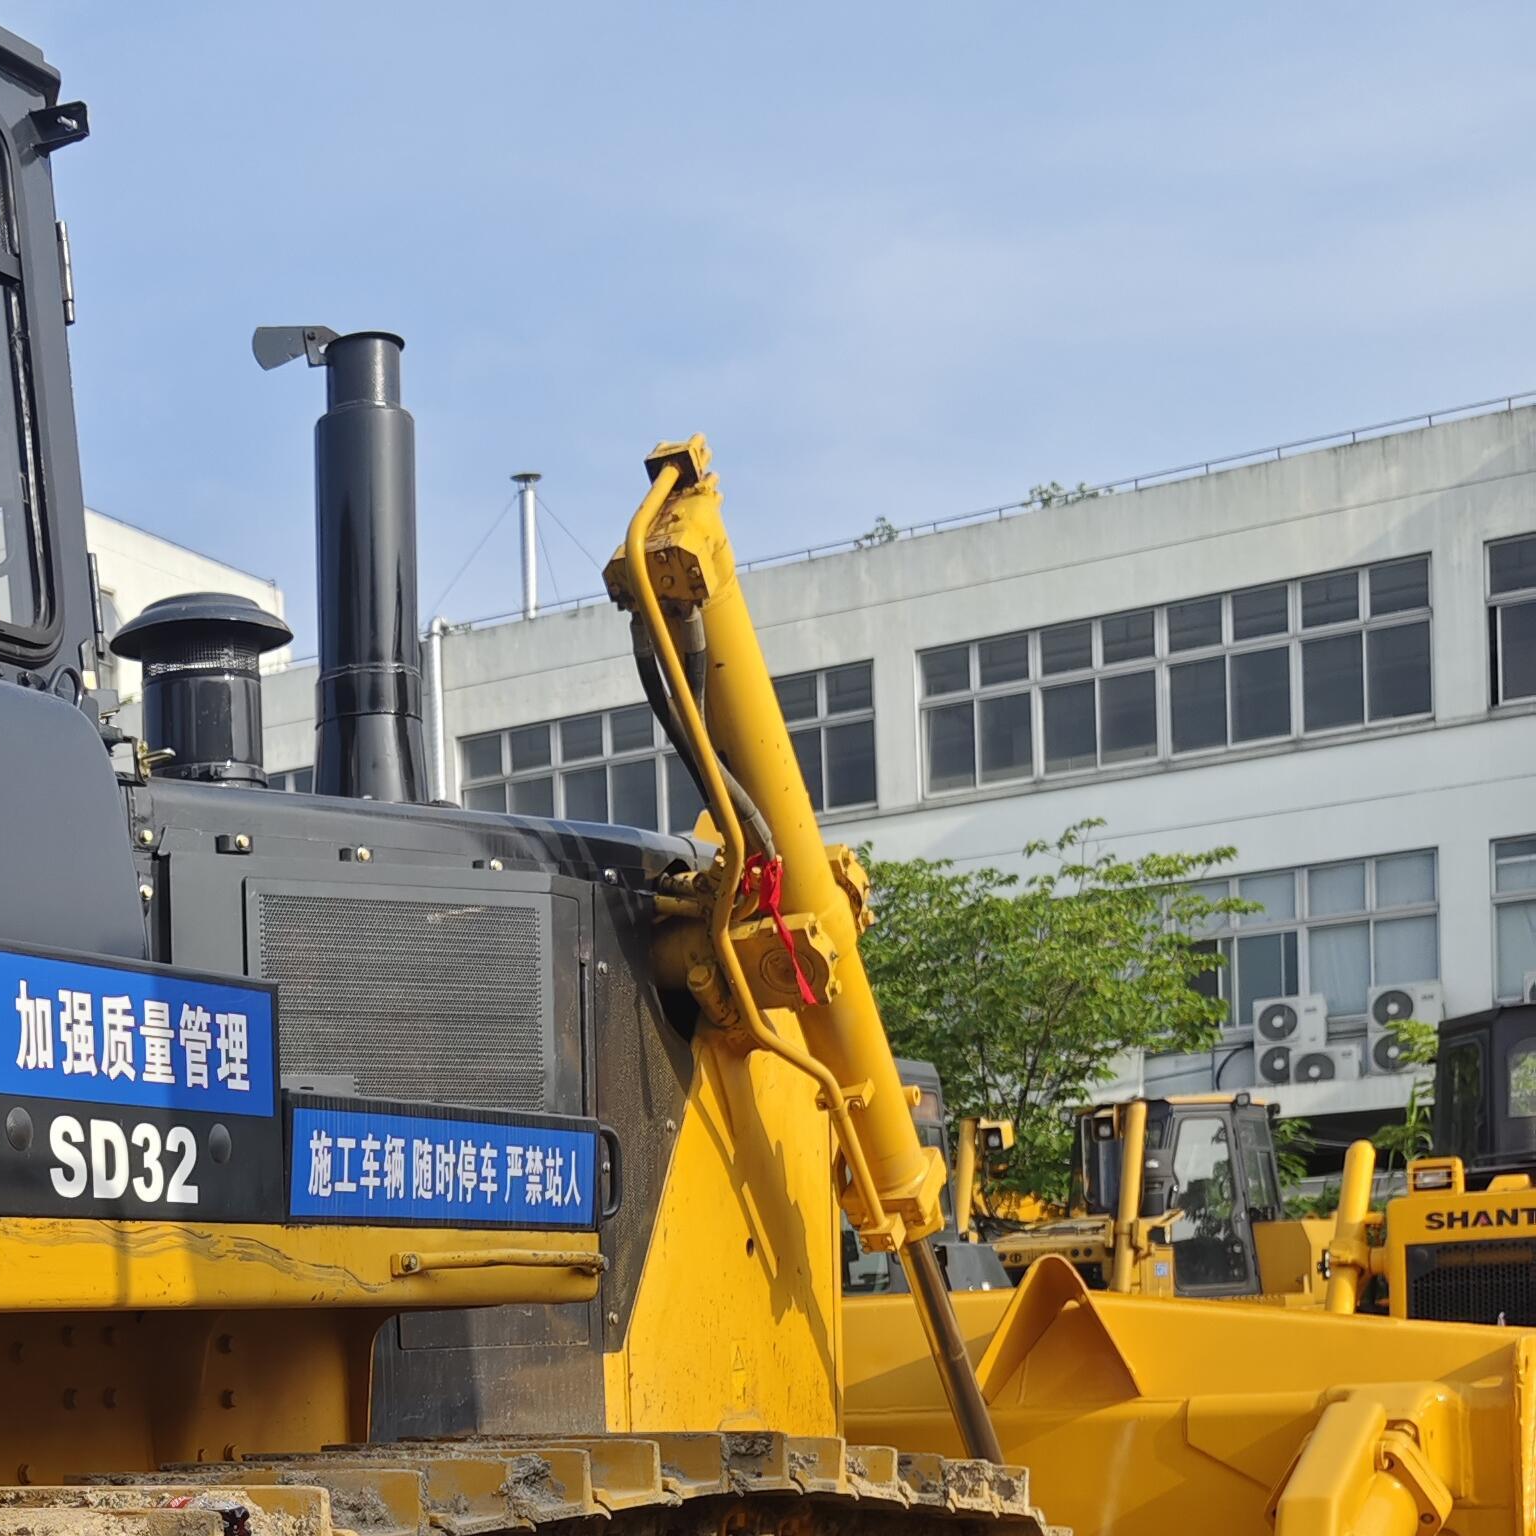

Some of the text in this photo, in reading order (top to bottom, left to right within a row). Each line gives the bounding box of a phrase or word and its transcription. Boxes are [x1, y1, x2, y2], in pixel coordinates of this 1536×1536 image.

[15, 979, 250, 1091] 加强质量管理
[49, 1115, 199, 1204] SD32
[308, 1129, 582, 1207] 施工车辆 随时停车 严禁站人
